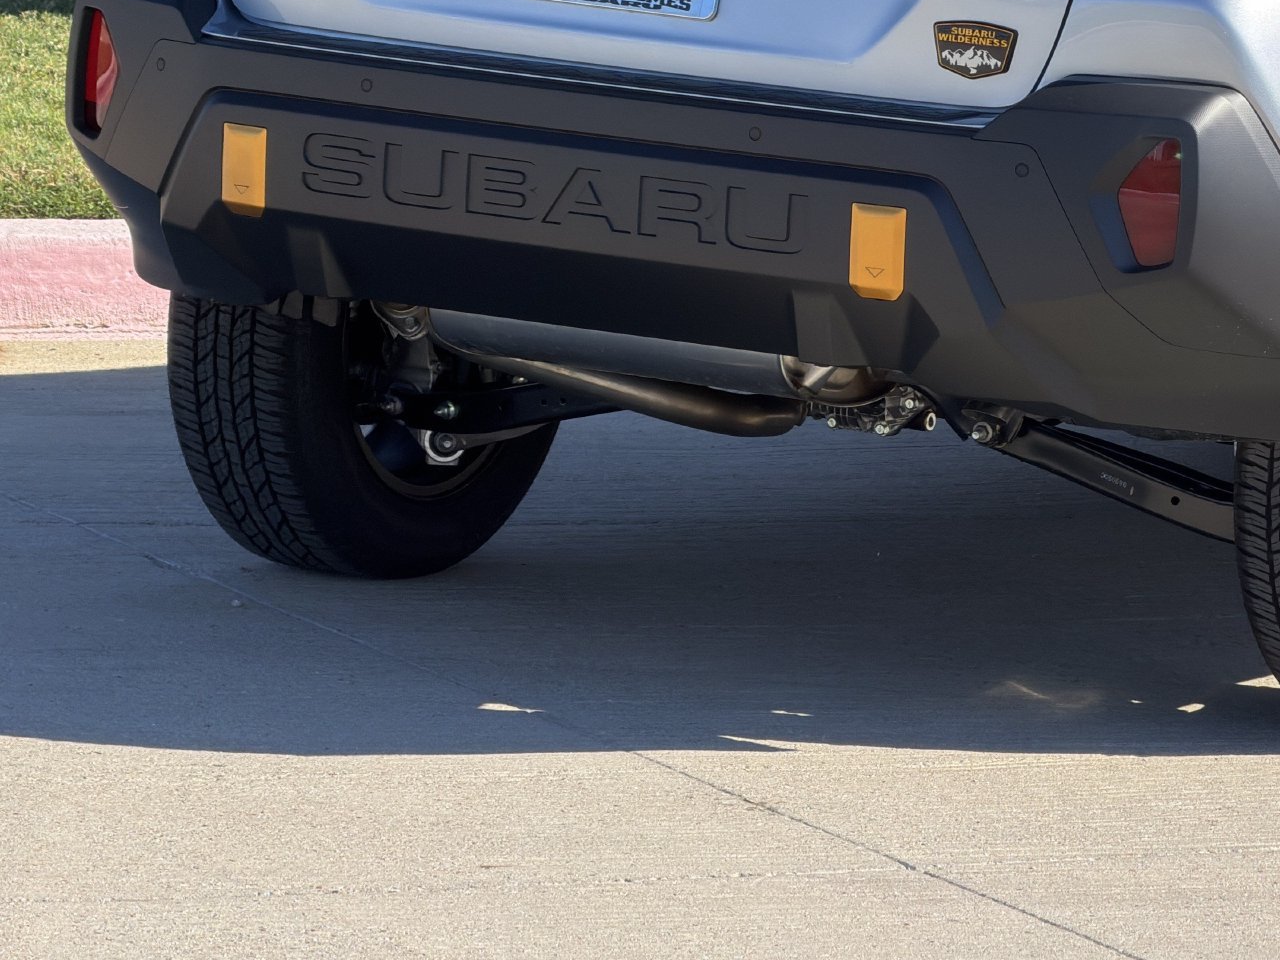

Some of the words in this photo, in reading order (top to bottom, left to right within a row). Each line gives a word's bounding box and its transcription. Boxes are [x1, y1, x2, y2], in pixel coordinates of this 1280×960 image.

[938, 33, 1008, 47] WILDERNESS
[951, 27, 996, 39] SUBARU
[301, 132, 809, 255] SUBARU
